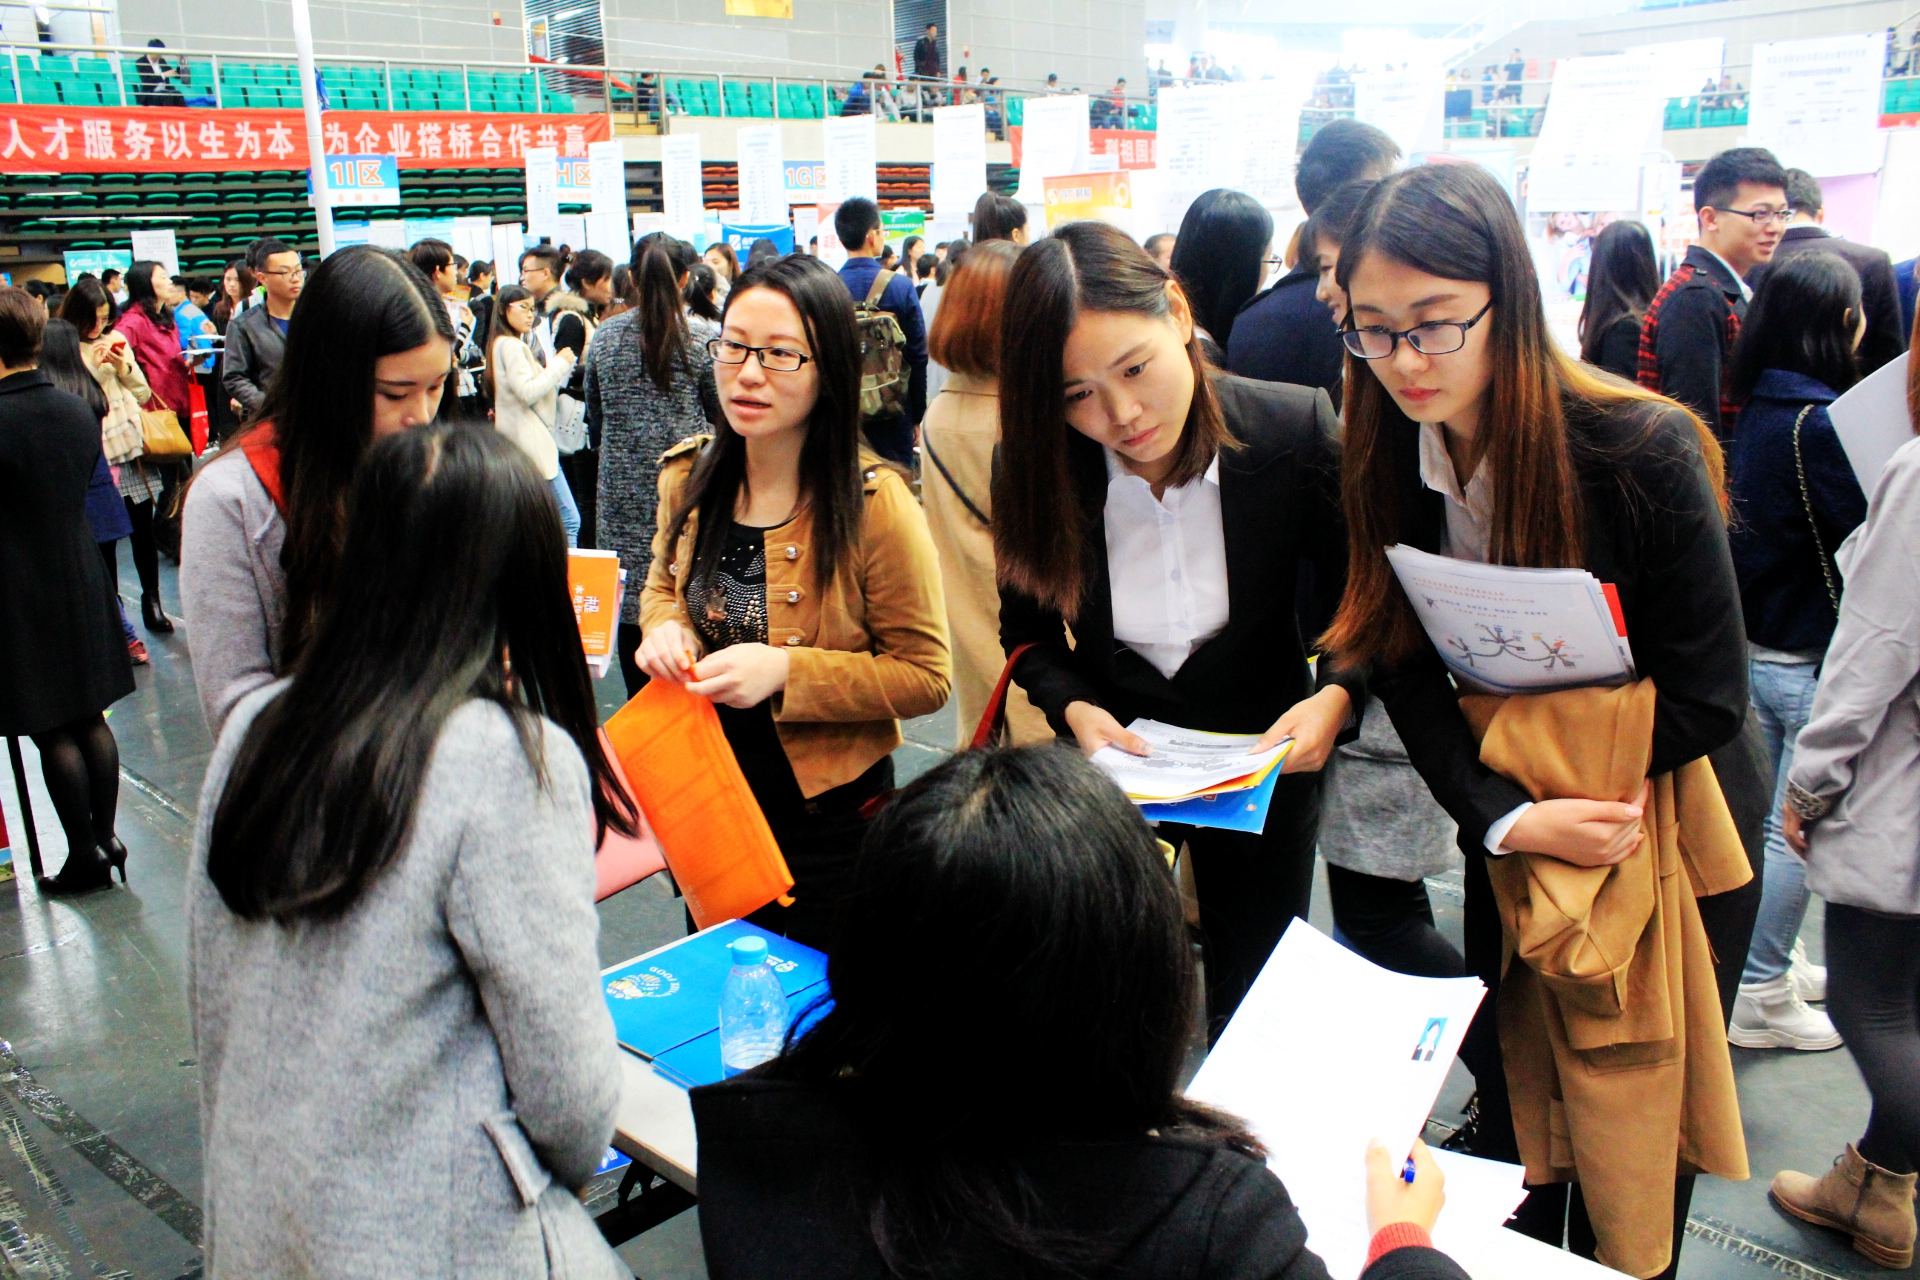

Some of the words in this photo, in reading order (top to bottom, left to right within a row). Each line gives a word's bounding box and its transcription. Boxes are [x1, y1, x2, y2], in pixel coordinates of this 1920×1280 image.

[2, 117, 296, 161] 人才服务以生为本
[325, 121, 587, 158] 为企业搭桥合作共赢
